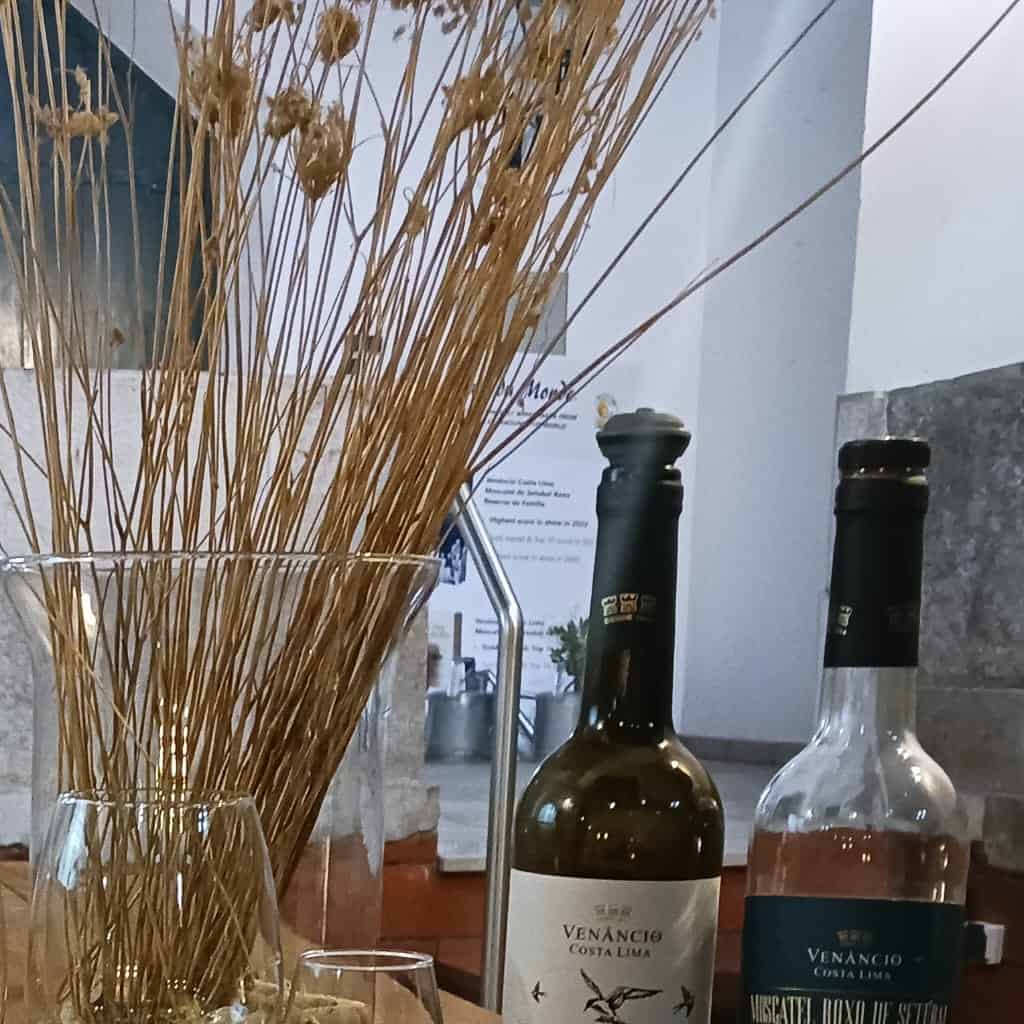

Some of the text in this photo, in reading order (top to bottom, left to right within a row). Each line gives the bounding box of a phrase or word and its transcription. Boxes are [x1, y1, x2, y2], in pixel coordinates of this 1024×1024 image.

[568, 943, 651, 958] COSTA LIMA
[813, 967, 855, 979] COSTA
